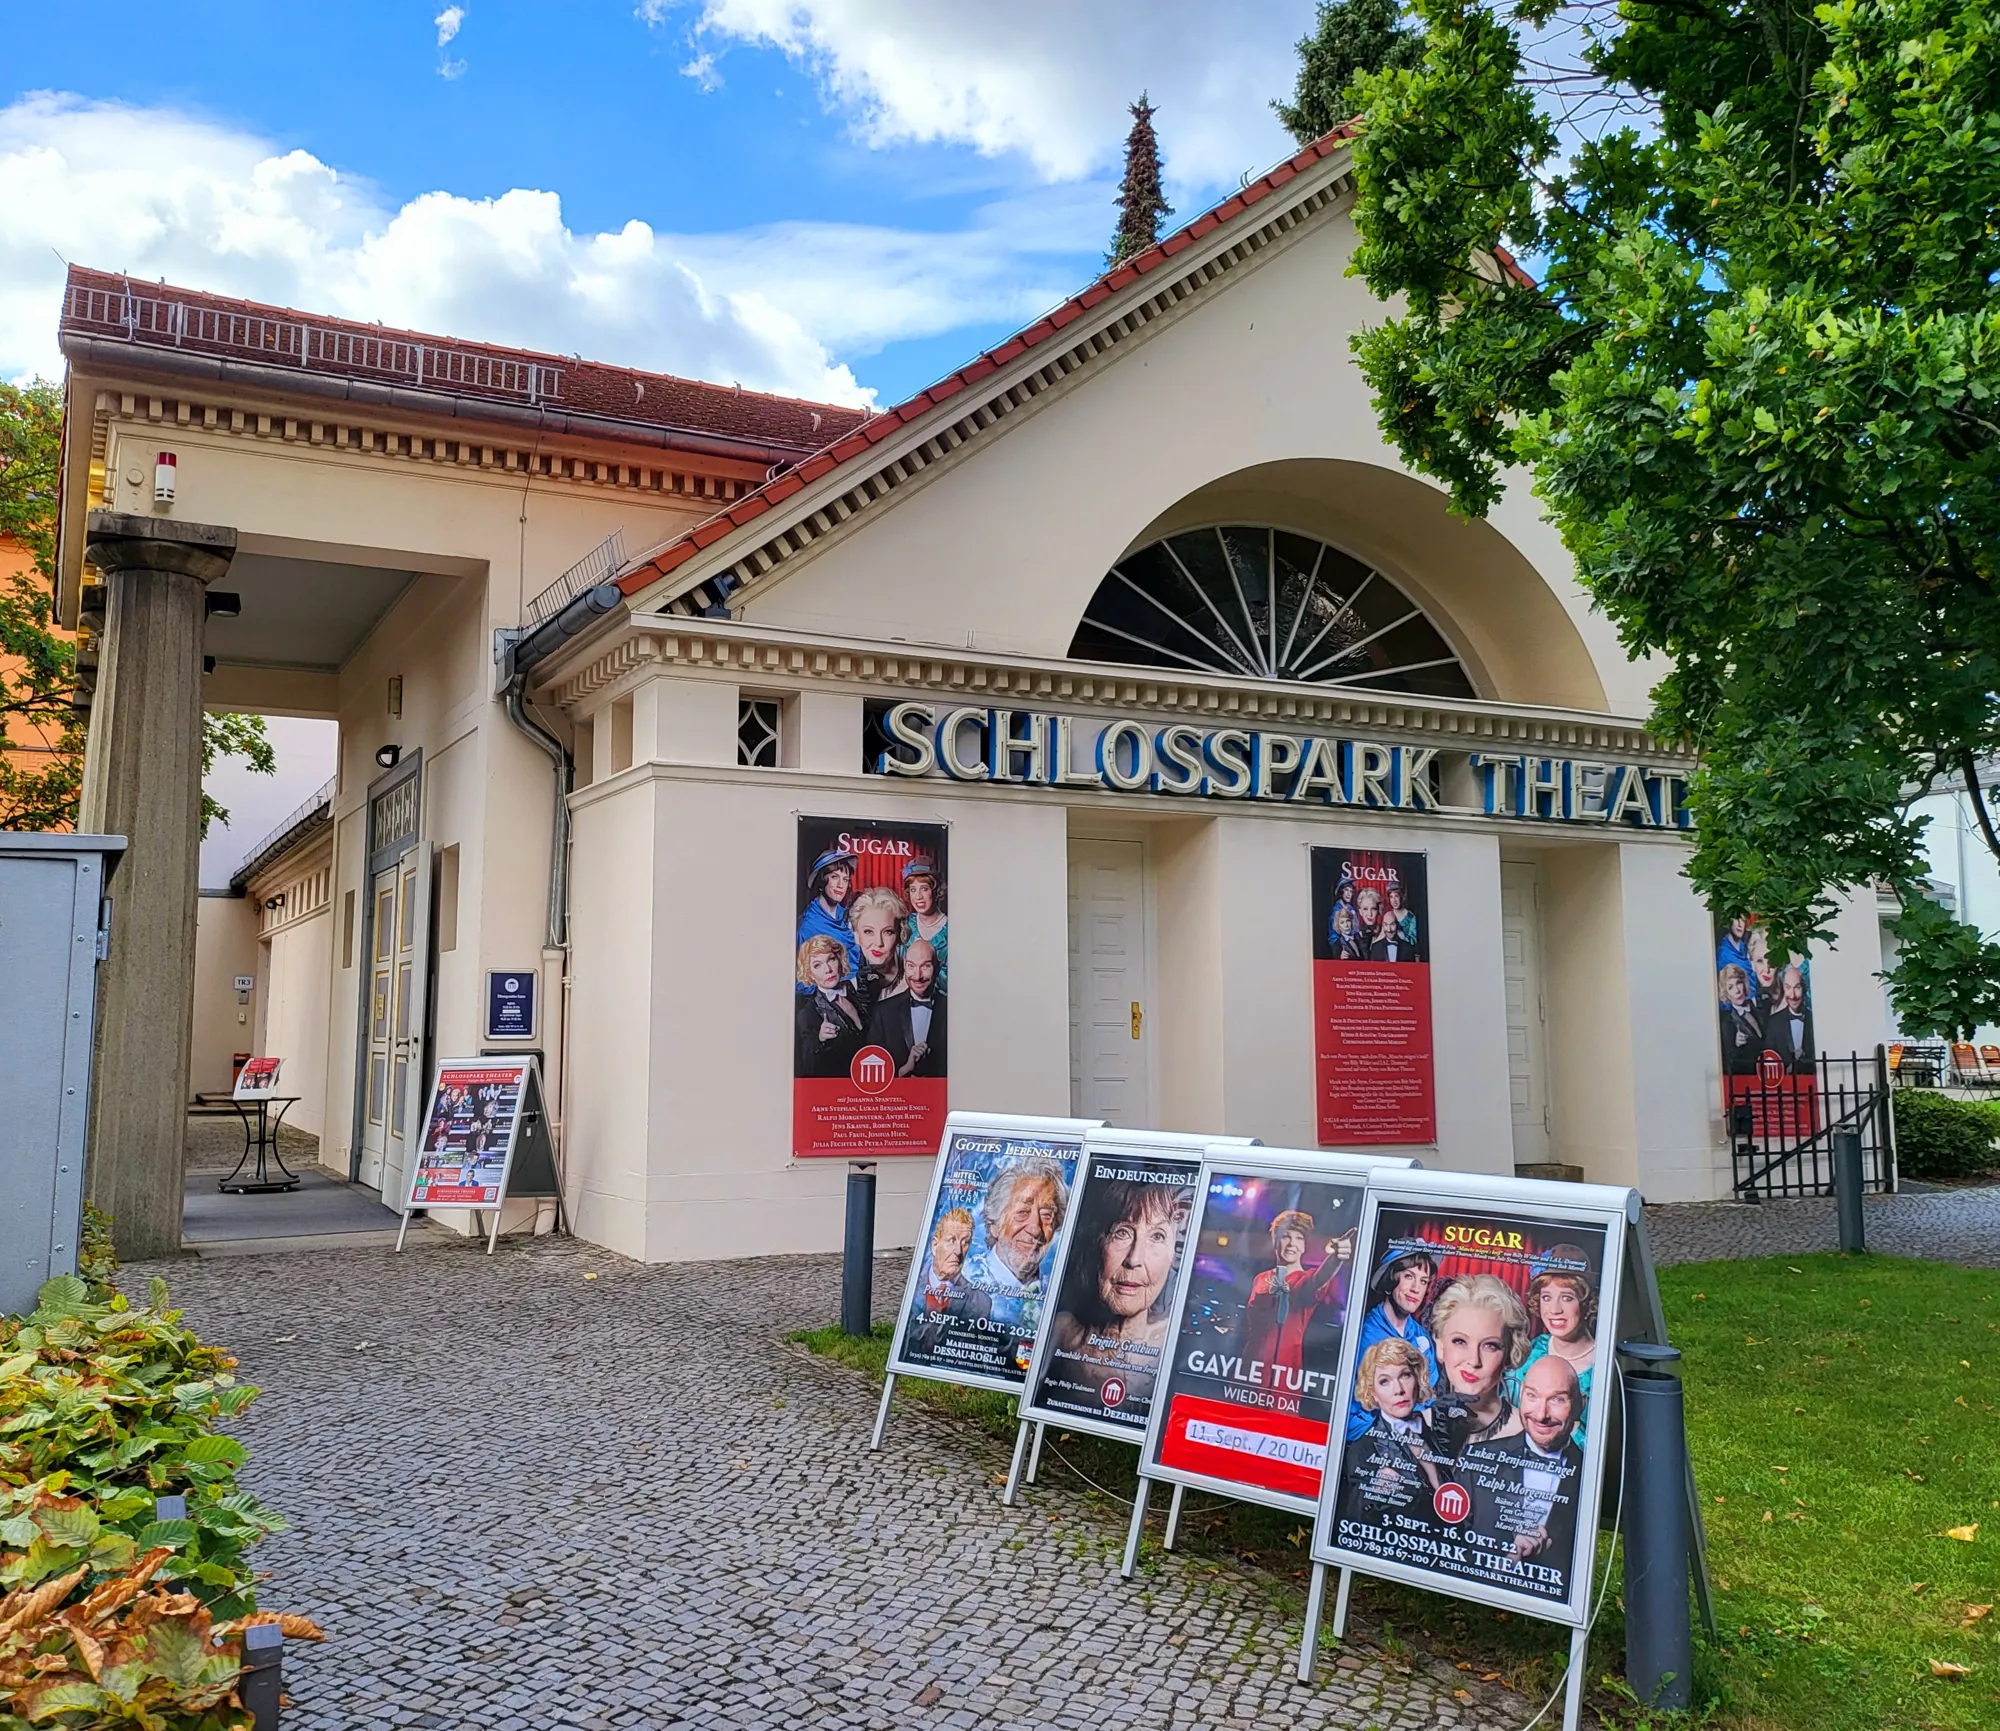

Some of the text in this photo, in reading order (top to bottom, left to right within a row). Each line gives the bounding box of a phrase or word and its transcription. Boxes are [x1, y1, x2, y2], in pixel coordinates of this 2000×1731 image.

[879, 702, 1697, 829] SCHLOSSPARK THEAT
[837, 832, 911, 856] SUGAR
[1341, 861, 1399, 882] SUGAR
[955, 1138, 1080, 1161] GOTTES LEBENSLAUF
[1094, 1165, 1116, 1179] EIN
[1117, 1168, 1185, 1185] DEUTSCHES
[1444, 1225, 1524, 1250] SUGAR
[923, 1279, 1046, 1301] Peter Bause Dieter Hallervorde
[916, 1312, 928, 1325] 4.
[967, 1318, 976, 1332] 7.
[977, 1317, 1005, 1334] OKT.
[1009, 1325, 1038, 1339] 2022
[945, 1338, 998, 1354] MARIENKIRCHE
[1088, 1335, 1160, 1356] Brigitte Grothum
[1143, 1365, 1158, 1377] Josep
[1187, 1350, 1336, 1397] GAYLE TUFT
[1223, 1385, 1300, 1413] WIEDER DA!
[1190, 1423, 1322, 1466] 11. Sept. / 20 Uhr
[1365, 1427, 1424, 1447] Arne Stephan
[1366, 1453, 1418, 1472] Antje Rietz
[1417, 1449, 1499, 1476] Johanna Spantzel
[1466, 1445, 1577, 1480] Lukas Benjamin Engel
[1476, 1475, 1569, 1505] Ralph Morgenstern
[1499, 1505, 1514, 1515] Tom
[1382, 1514, 1393, 1526] 3.
[1395, 1514, 1431, 1534] SEPT.
[1442, 1527, 1461, 1542] 16.
[1464, 1530, 1498, 1550] OKT.
[1500, 1541, 1517, 1555] 22
[1338, 1519, 1564, 1586] SCHLOSSPARK THEATER
[1337, 1534, 1362, 1550] (030)
[1363, 1541, 1381, 1555] 789
[1382, 1546, 1395, 1556] 56
[1429, 1557, 1438, 1568] /
[1439, 1560, 1562, 1597] SCHLOSSPARKTHEATER.DE
